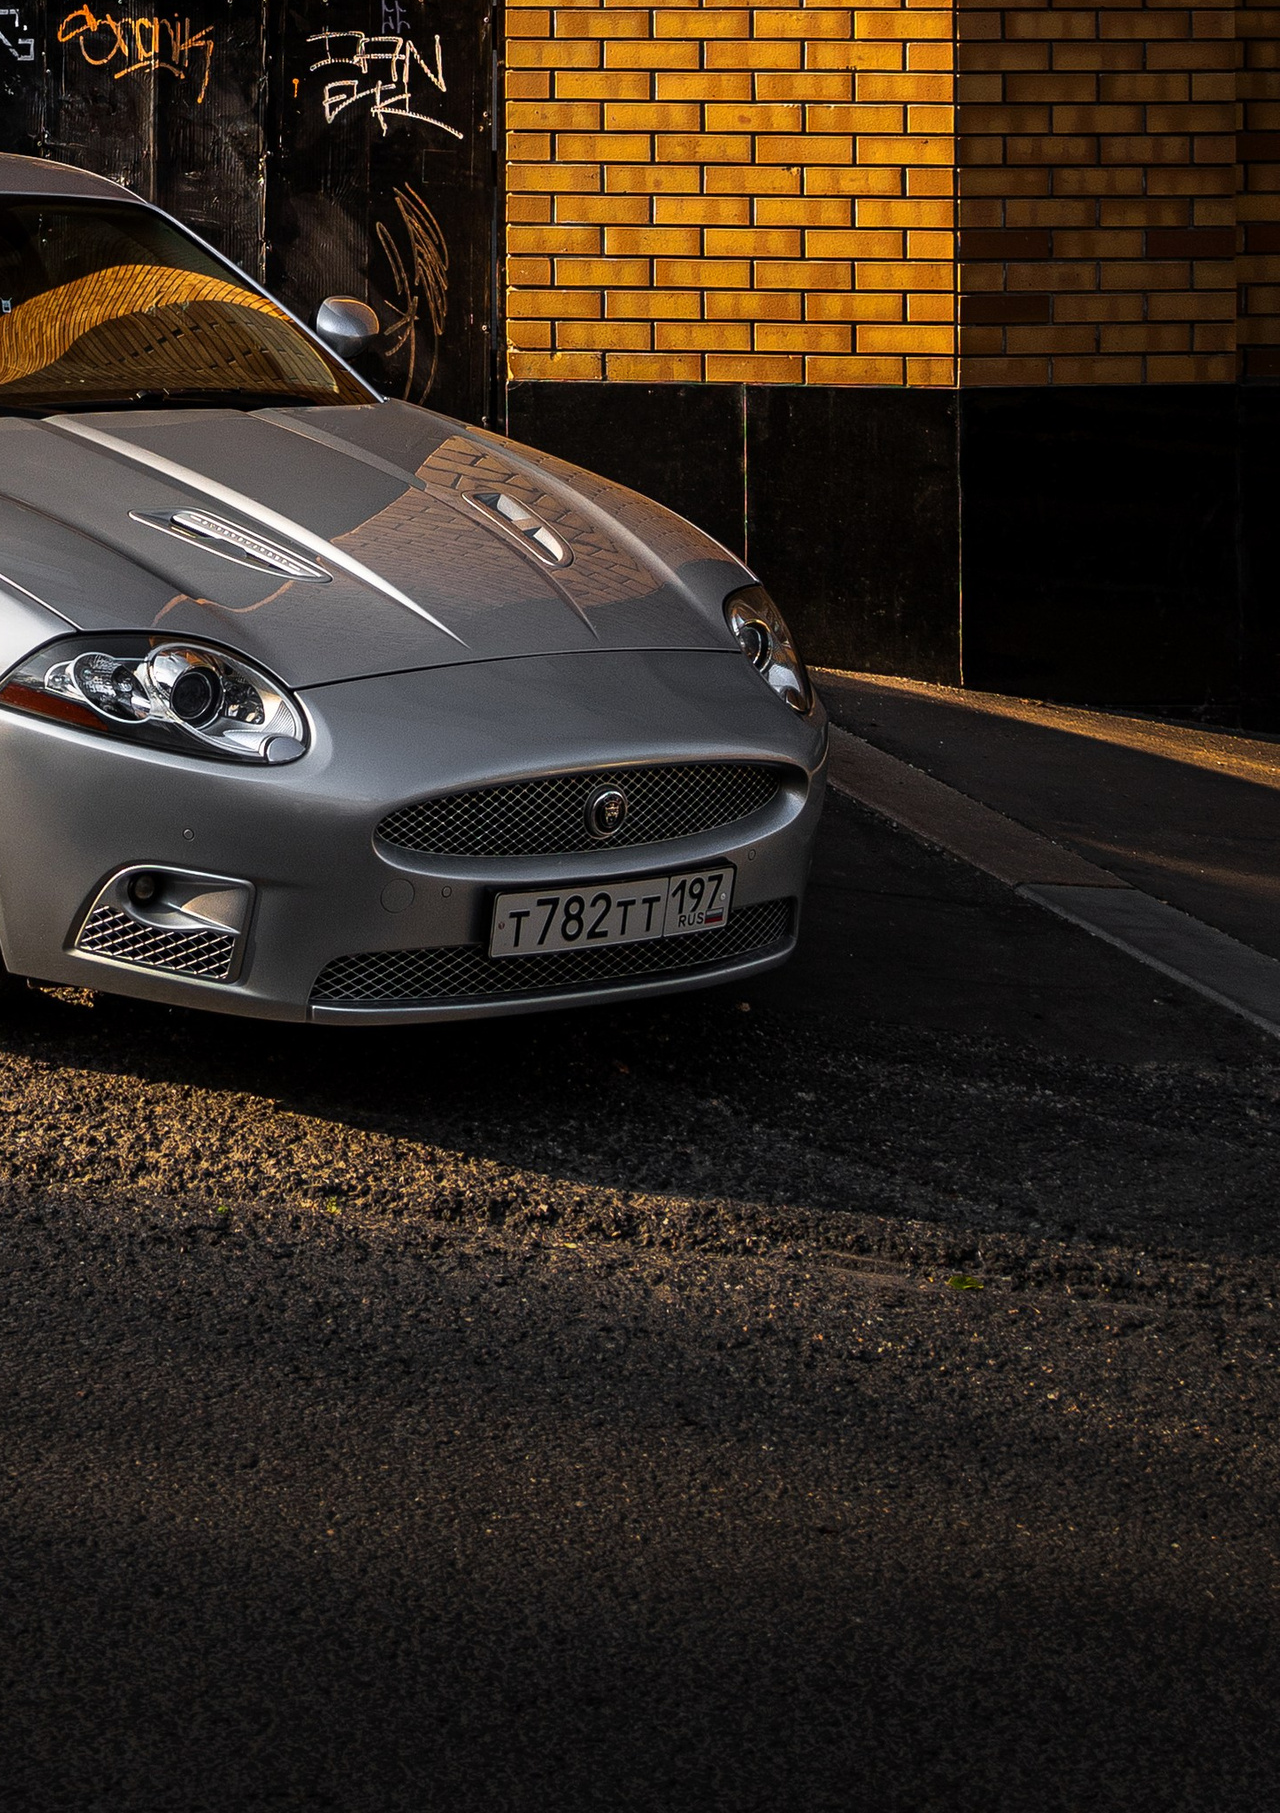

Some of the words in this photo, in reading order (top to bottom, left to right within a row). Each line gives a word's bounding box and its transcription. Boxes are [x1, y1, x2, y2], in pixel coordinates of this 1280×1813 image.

[508, 891, 662, 948] T782TT
[671, 874, 725, 914] 197
[677, 911, 705, 928] RUS
